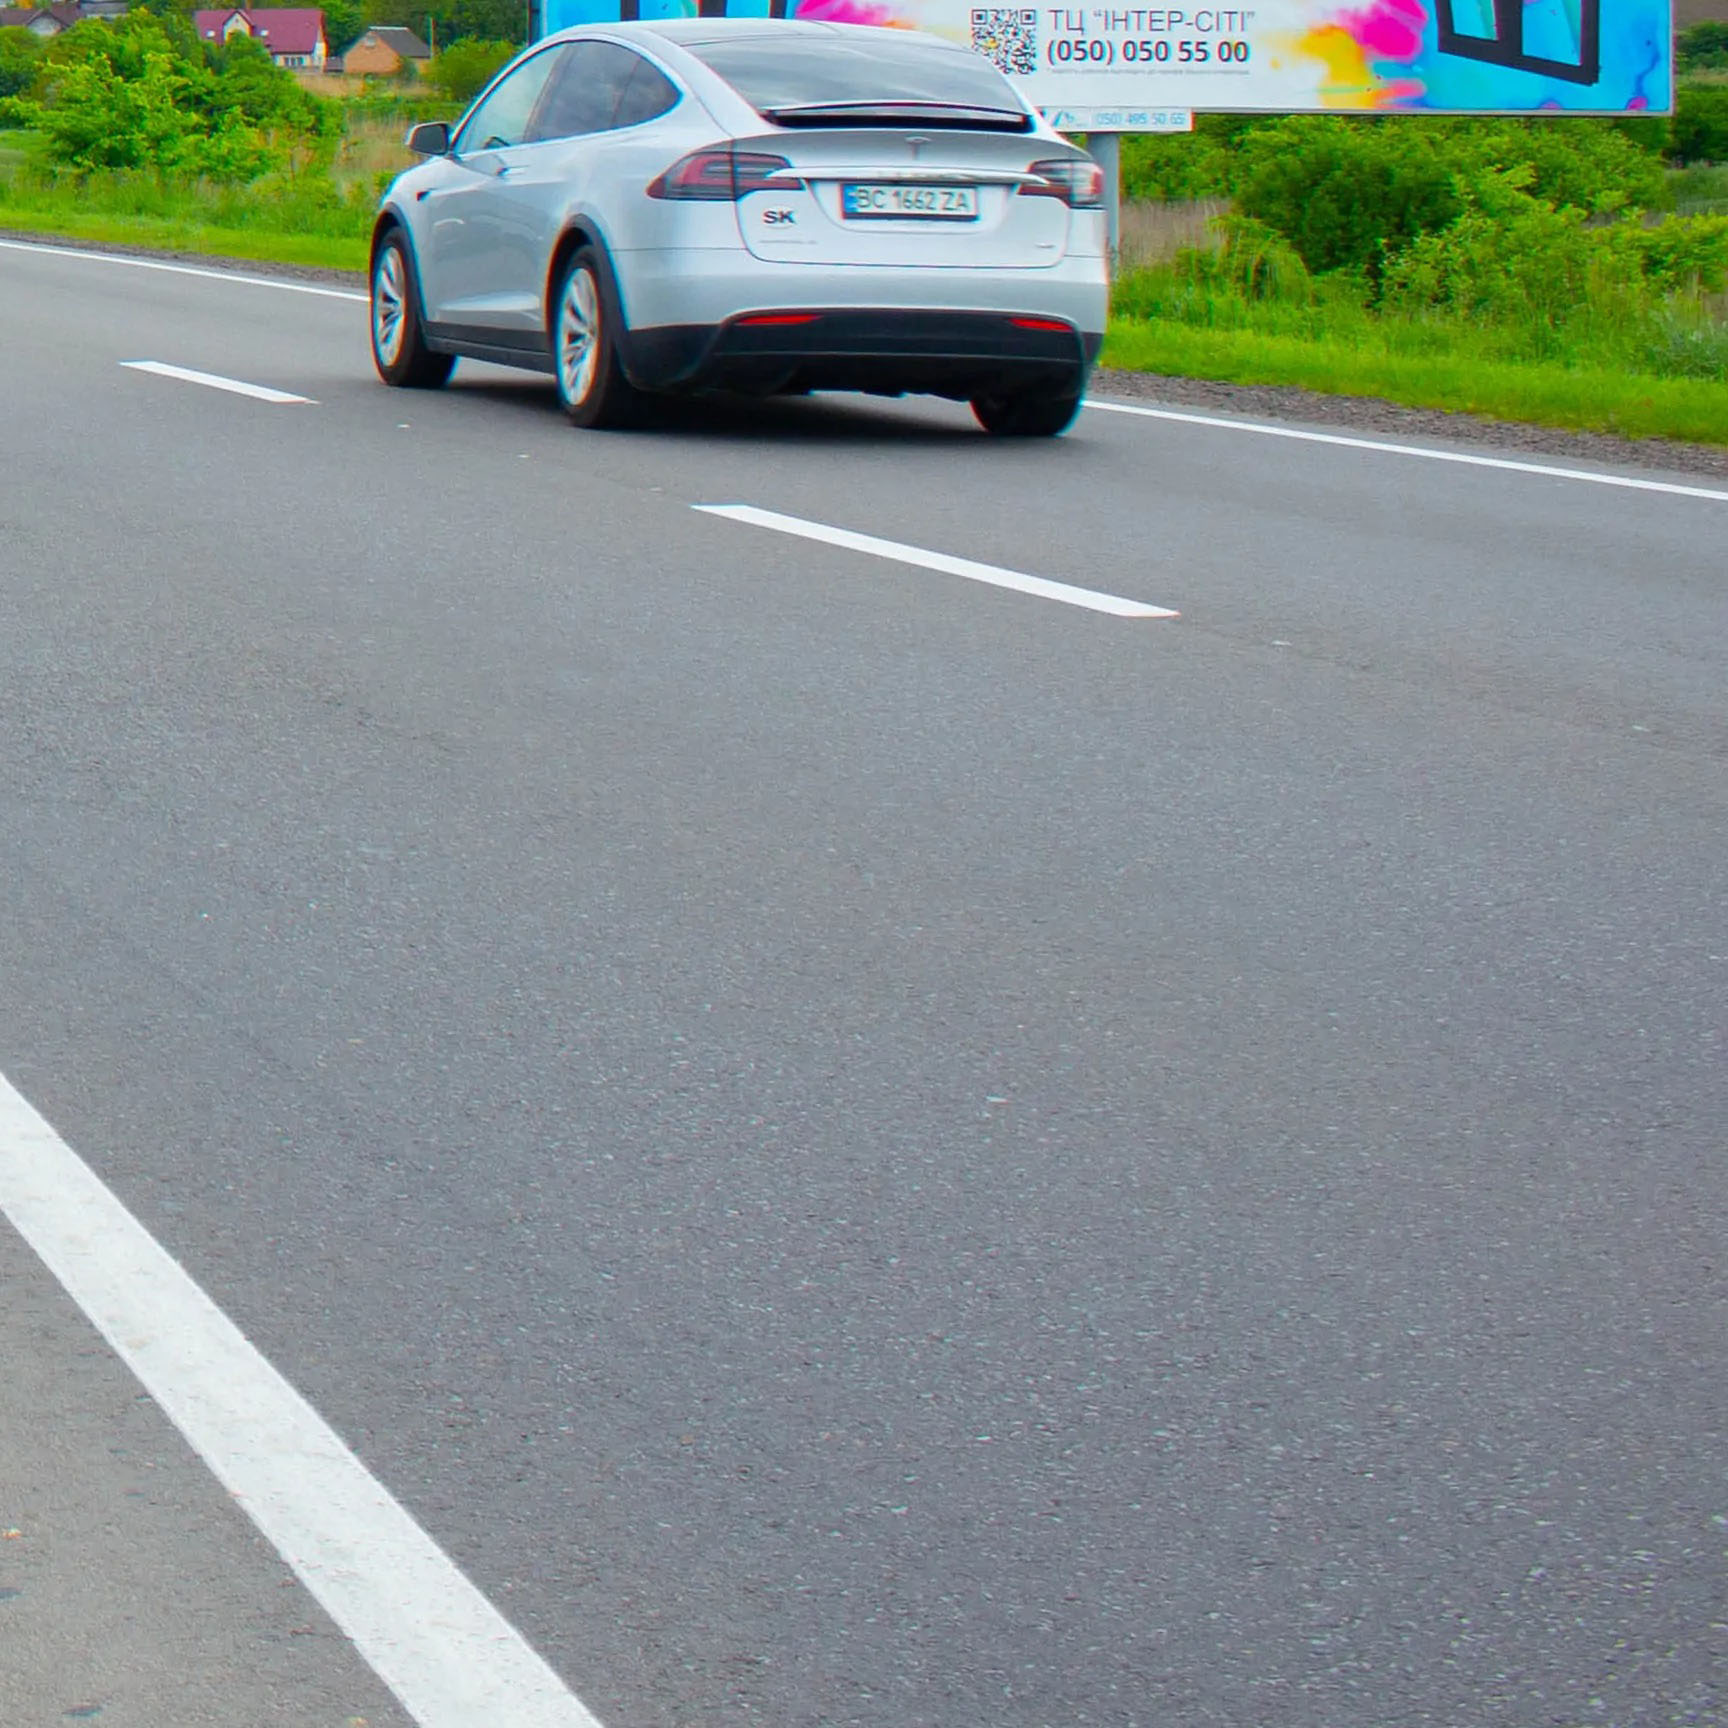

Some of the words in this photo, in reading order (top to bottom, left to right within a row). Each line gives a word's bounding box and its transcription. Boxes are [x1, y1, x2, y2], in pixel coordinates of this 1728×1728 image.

[1048, 9, 1085, 35] ТЦ
[1047, 39, 1113, 65] (050)
[1122, 40, 1169, 62] 050
[1178, 41, 1208, 62] 55
[1217, 41, 1249, 62] 00
[857, 188, 887, 209] BC
[892, 190, 937, 210] 1662
[939, 190, 969, 211] ZA
[763, 210, 796, 225] SK
